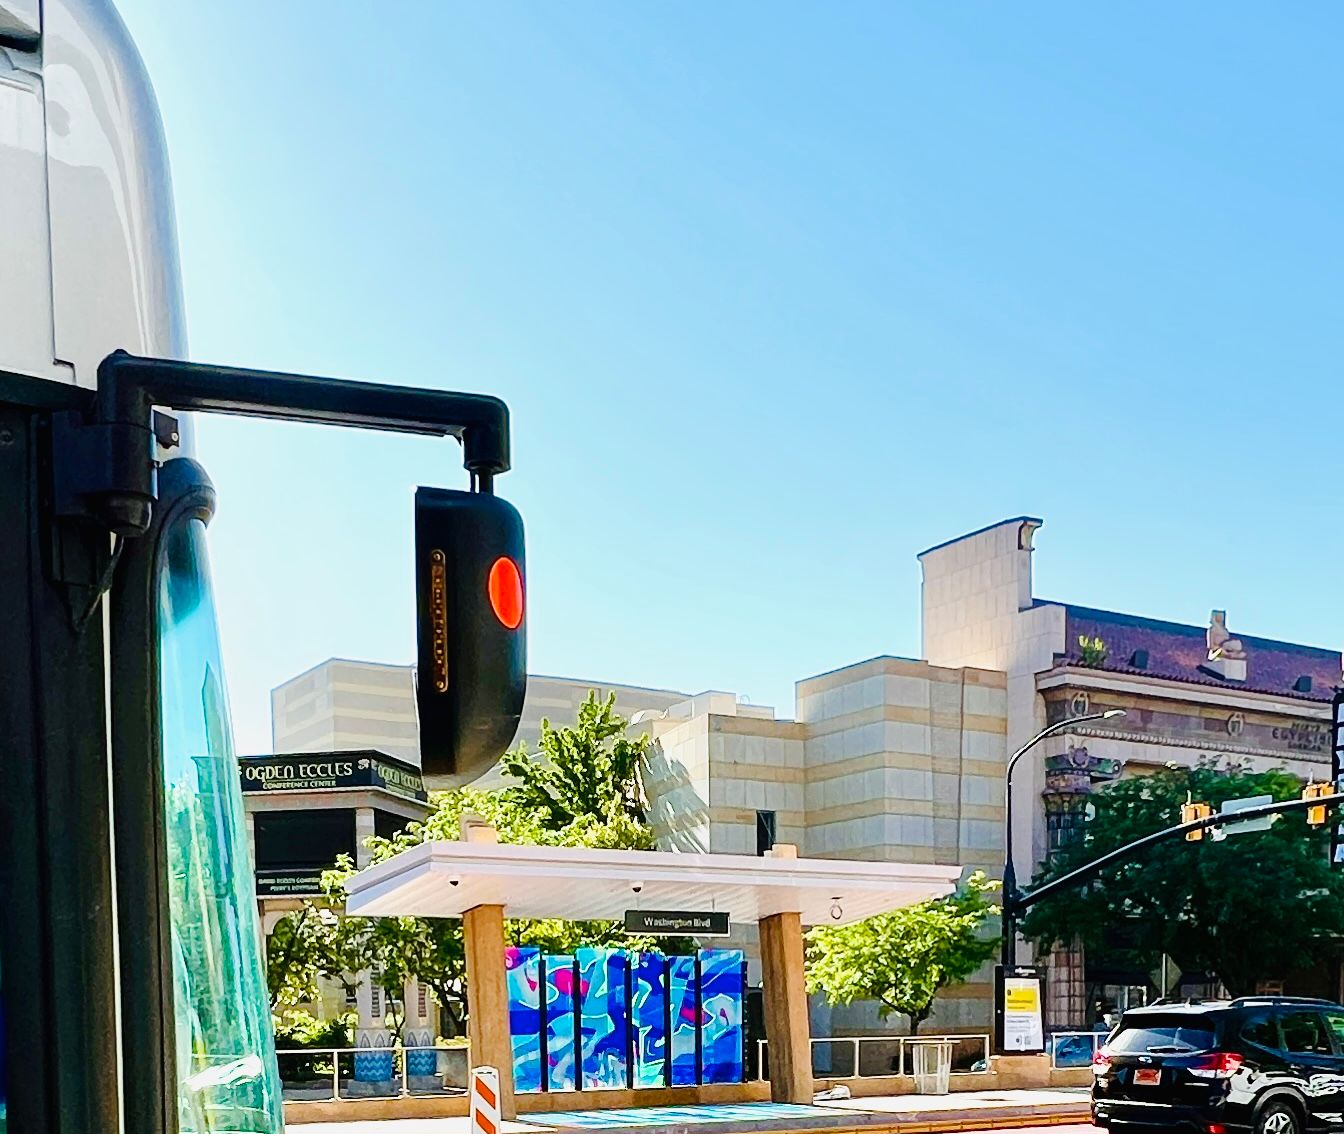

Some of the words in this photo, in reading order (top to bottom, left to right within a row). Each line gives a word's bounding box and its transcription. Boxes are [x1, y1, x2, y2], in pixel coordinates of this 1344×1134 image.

[246, 765, 294, 783] OGDEN
[299, 762, 353, 778] ECCLES
[263, 780, 308, 790] CONFERENCE
[310, 779, 336, 788] CENTER
